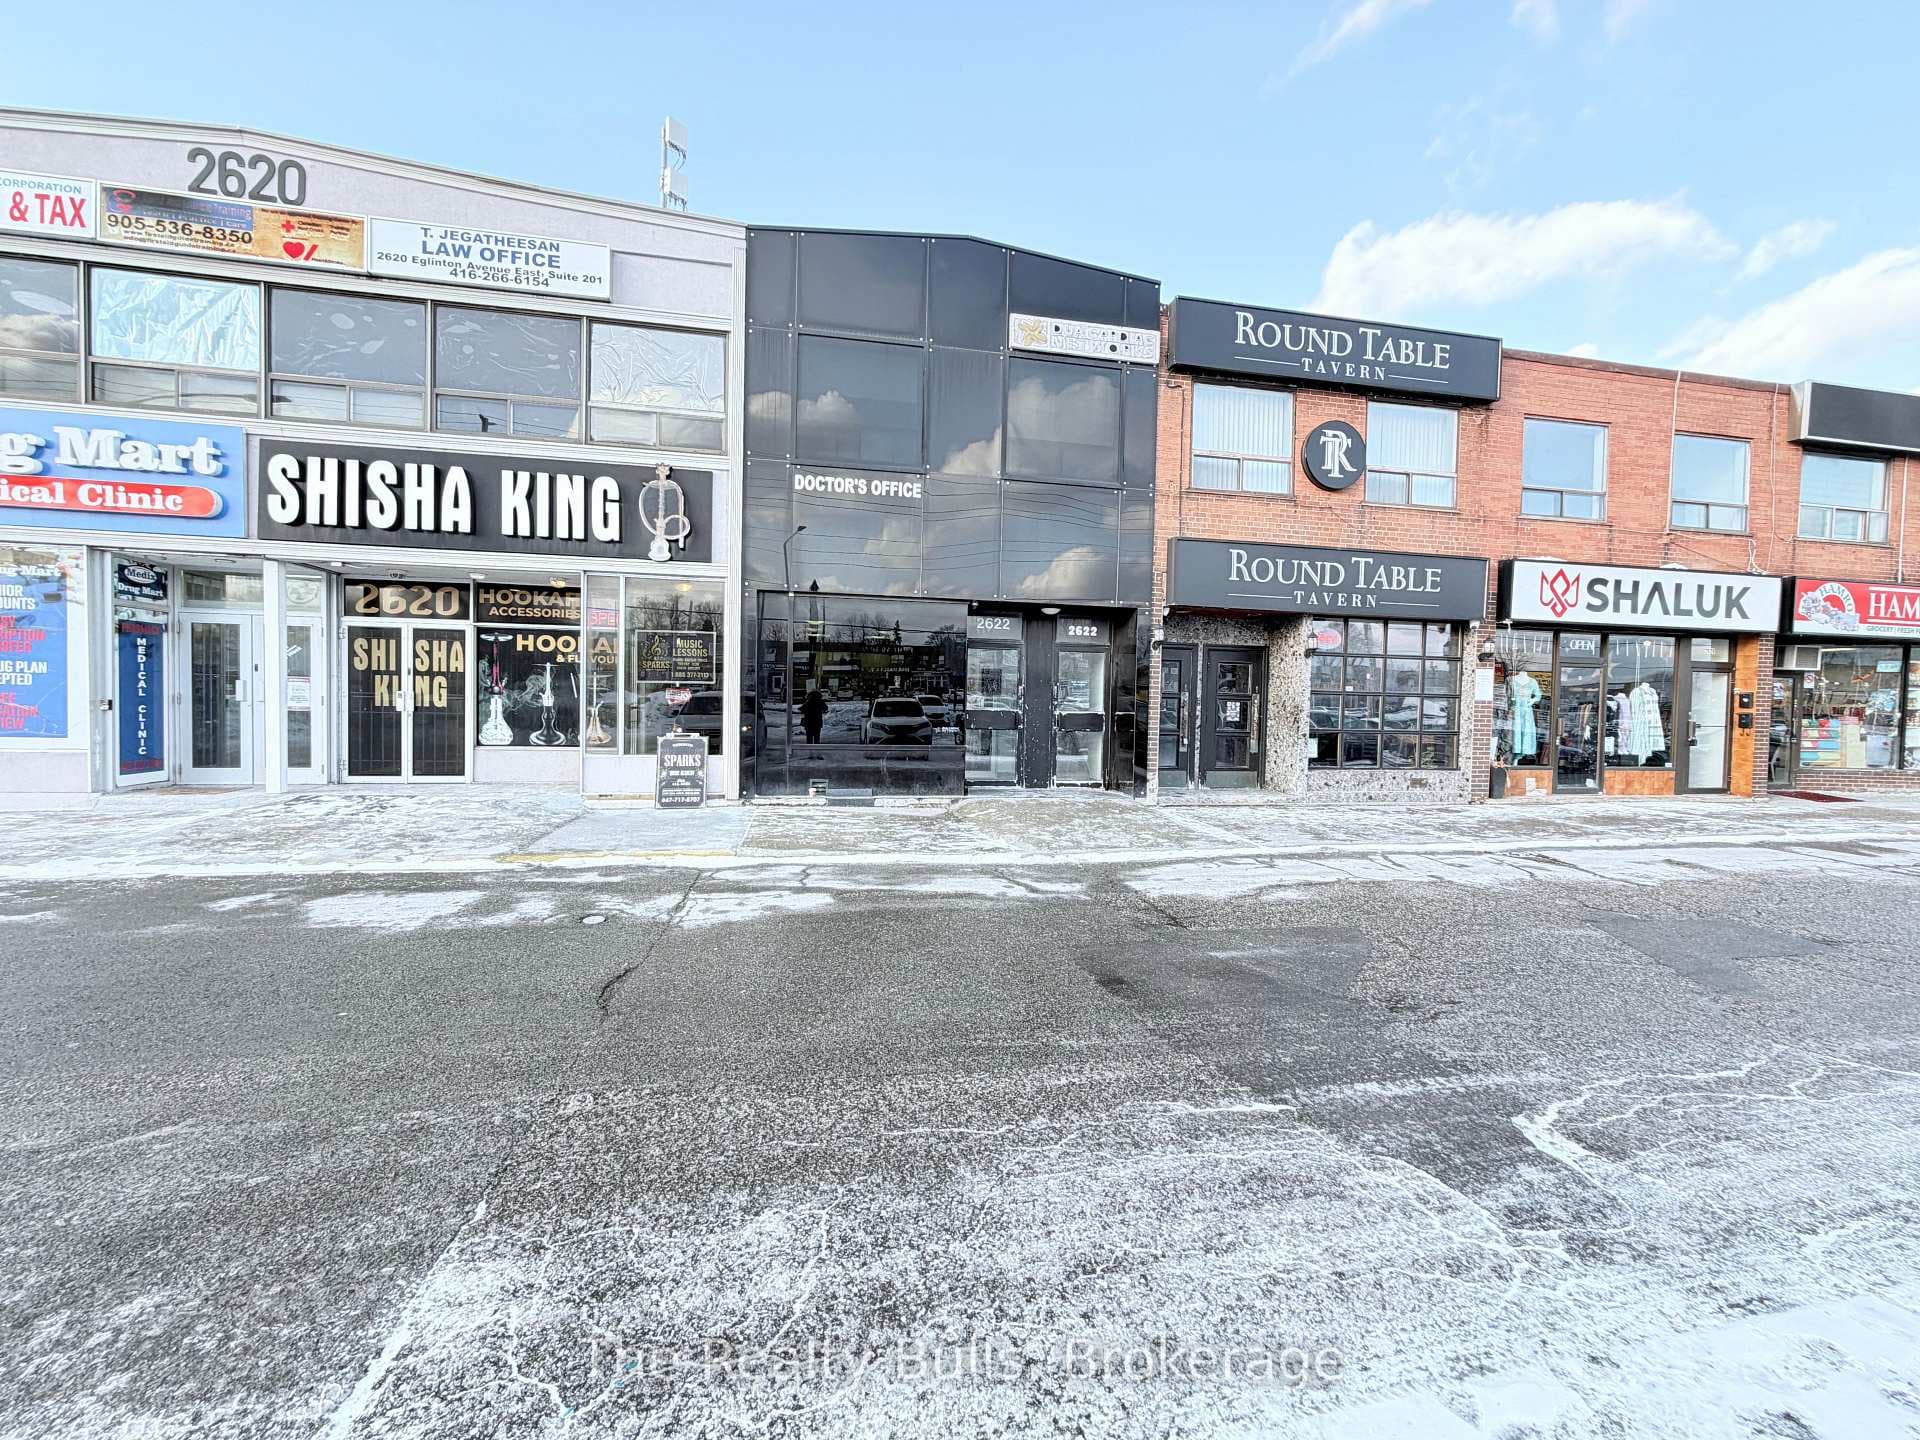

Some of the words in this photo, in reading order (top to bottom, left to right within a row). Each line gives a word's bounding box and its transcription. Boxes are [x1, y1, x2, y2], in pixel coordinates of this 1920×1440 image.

[0, 177, 81, 194] ORPORATION
[187, 147, 307, 206] 2620
[9, 191, 29, 222] &
[34, 193, 87, 228] TAX
[107, 213, 253, 244] 905-536-8350
[420, 227, 434, 238] T.
[439, 229, 560, 252] JEGATHEESAN
[421, 240, 472, 259] LAW
[480, 247, 561, 269] OFFICE
[377, 251, 407, 263] 2620
[411, 255, 461, 269] Eglinton
[467, 261, 510, 274] Avenue
[548, 270, 578, 282] Suite
[582, 274, 603, 285] 201
[449, 268, 550, 288] 416-266-6154
[1235, 311, 1353, 357] ROUND
[1358, 327, 1450, 369] TABLE
[1302, 357, 1386, 381] TAVERN
[53, 426, 224, 477] Mart
[77, 483, 184, 511] Clinic
[267, 453, 474, 535] SHISHA
[501, 469, 622, 542] KING
[794, 474, 868, 495] DOCTOR'S
[870, 480, 923, 499] OFFICE
[126, 567, 156, 581] Medix
[1228, 549, 1345, 587] ROUND
[1351, 556, 1442, 593] TABLE
[118, 582, 141, 595] Drug
[142, 586, 164, 598] Mart
[355, 583, 460, 616] 2620
[480, 588, 581, 609] HOOKAH
[1293, 590, 1377, 608] TAVERN
[1586, 577, 1751, 620] SHALUK
[1819, 583, 1855, 614] HAMRO
[489, 606, 581, 620] ACCESSORIES
[976, 618, 1011, 630] 2622
[676, 638, 704, 649] MUSIC
[1068, 626, 1098, 637] 2622
[672, 648, 708, 657] LESSONS
[1569, 638, 1595, 655] OPEN
[16, 661, 48, 673] PLAN
[136, 637, 147, 696] MEDICAL
[641, 661, 672, 669] SPARKS
[137, 705, 148, 755] CLINIC
[663, 754, 702, 767] SPARKS
